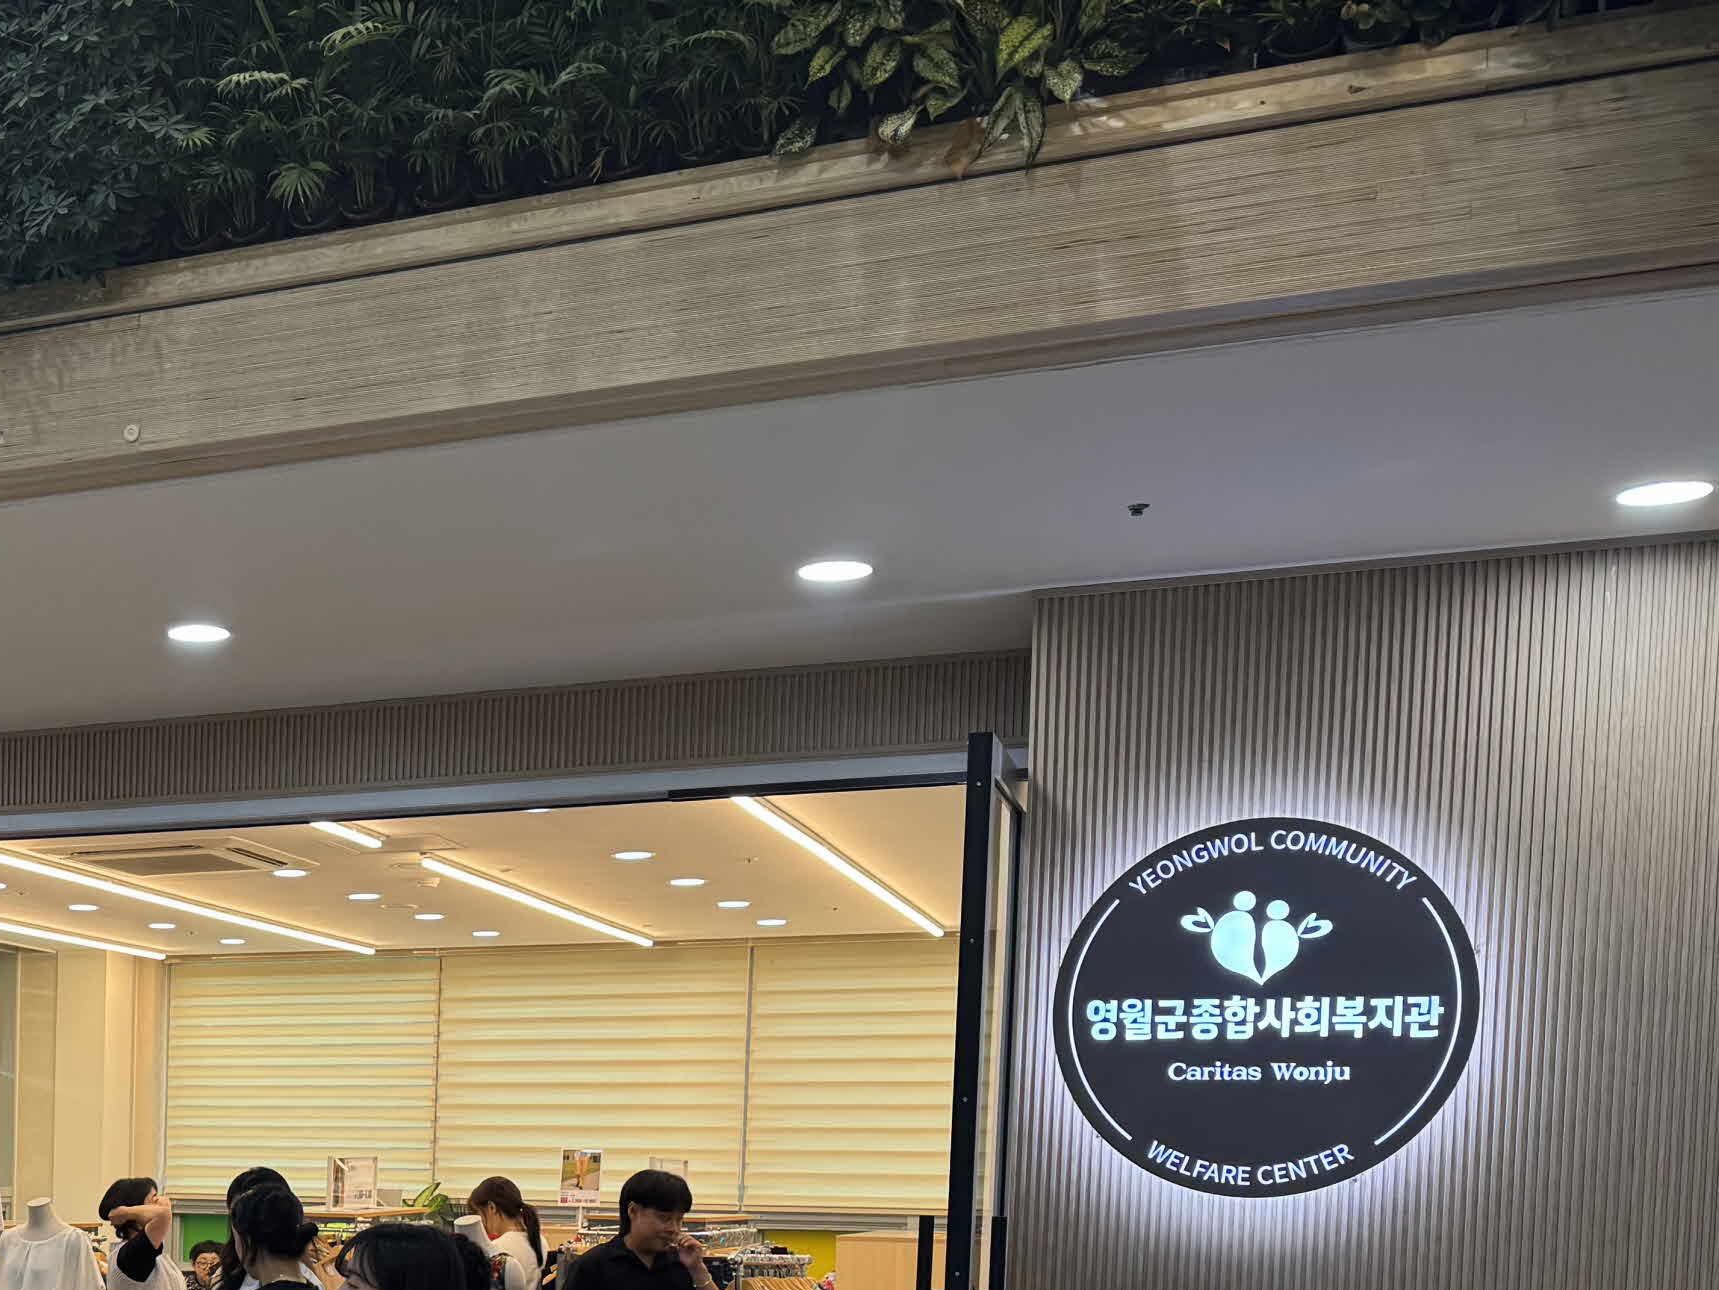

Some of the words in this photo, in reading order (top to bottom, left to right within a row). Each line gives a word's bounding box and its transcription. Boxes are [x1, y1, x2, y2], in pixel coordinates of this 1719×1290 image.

[1128, 832, 1264, 896] YEONGWOL
[1270, 829, 1417, 891] COMMUNITY
[1086, 995, 1445, 1041] 영월군종합사회복지관
[1167, 1062, 1262, 1082] Caritas
[1270, 1062, 1351, 1085] Wonju
[1147, 1140, 1251, 1186] WELFARE
[1257, 1143, 1354, 1185] CENTER
